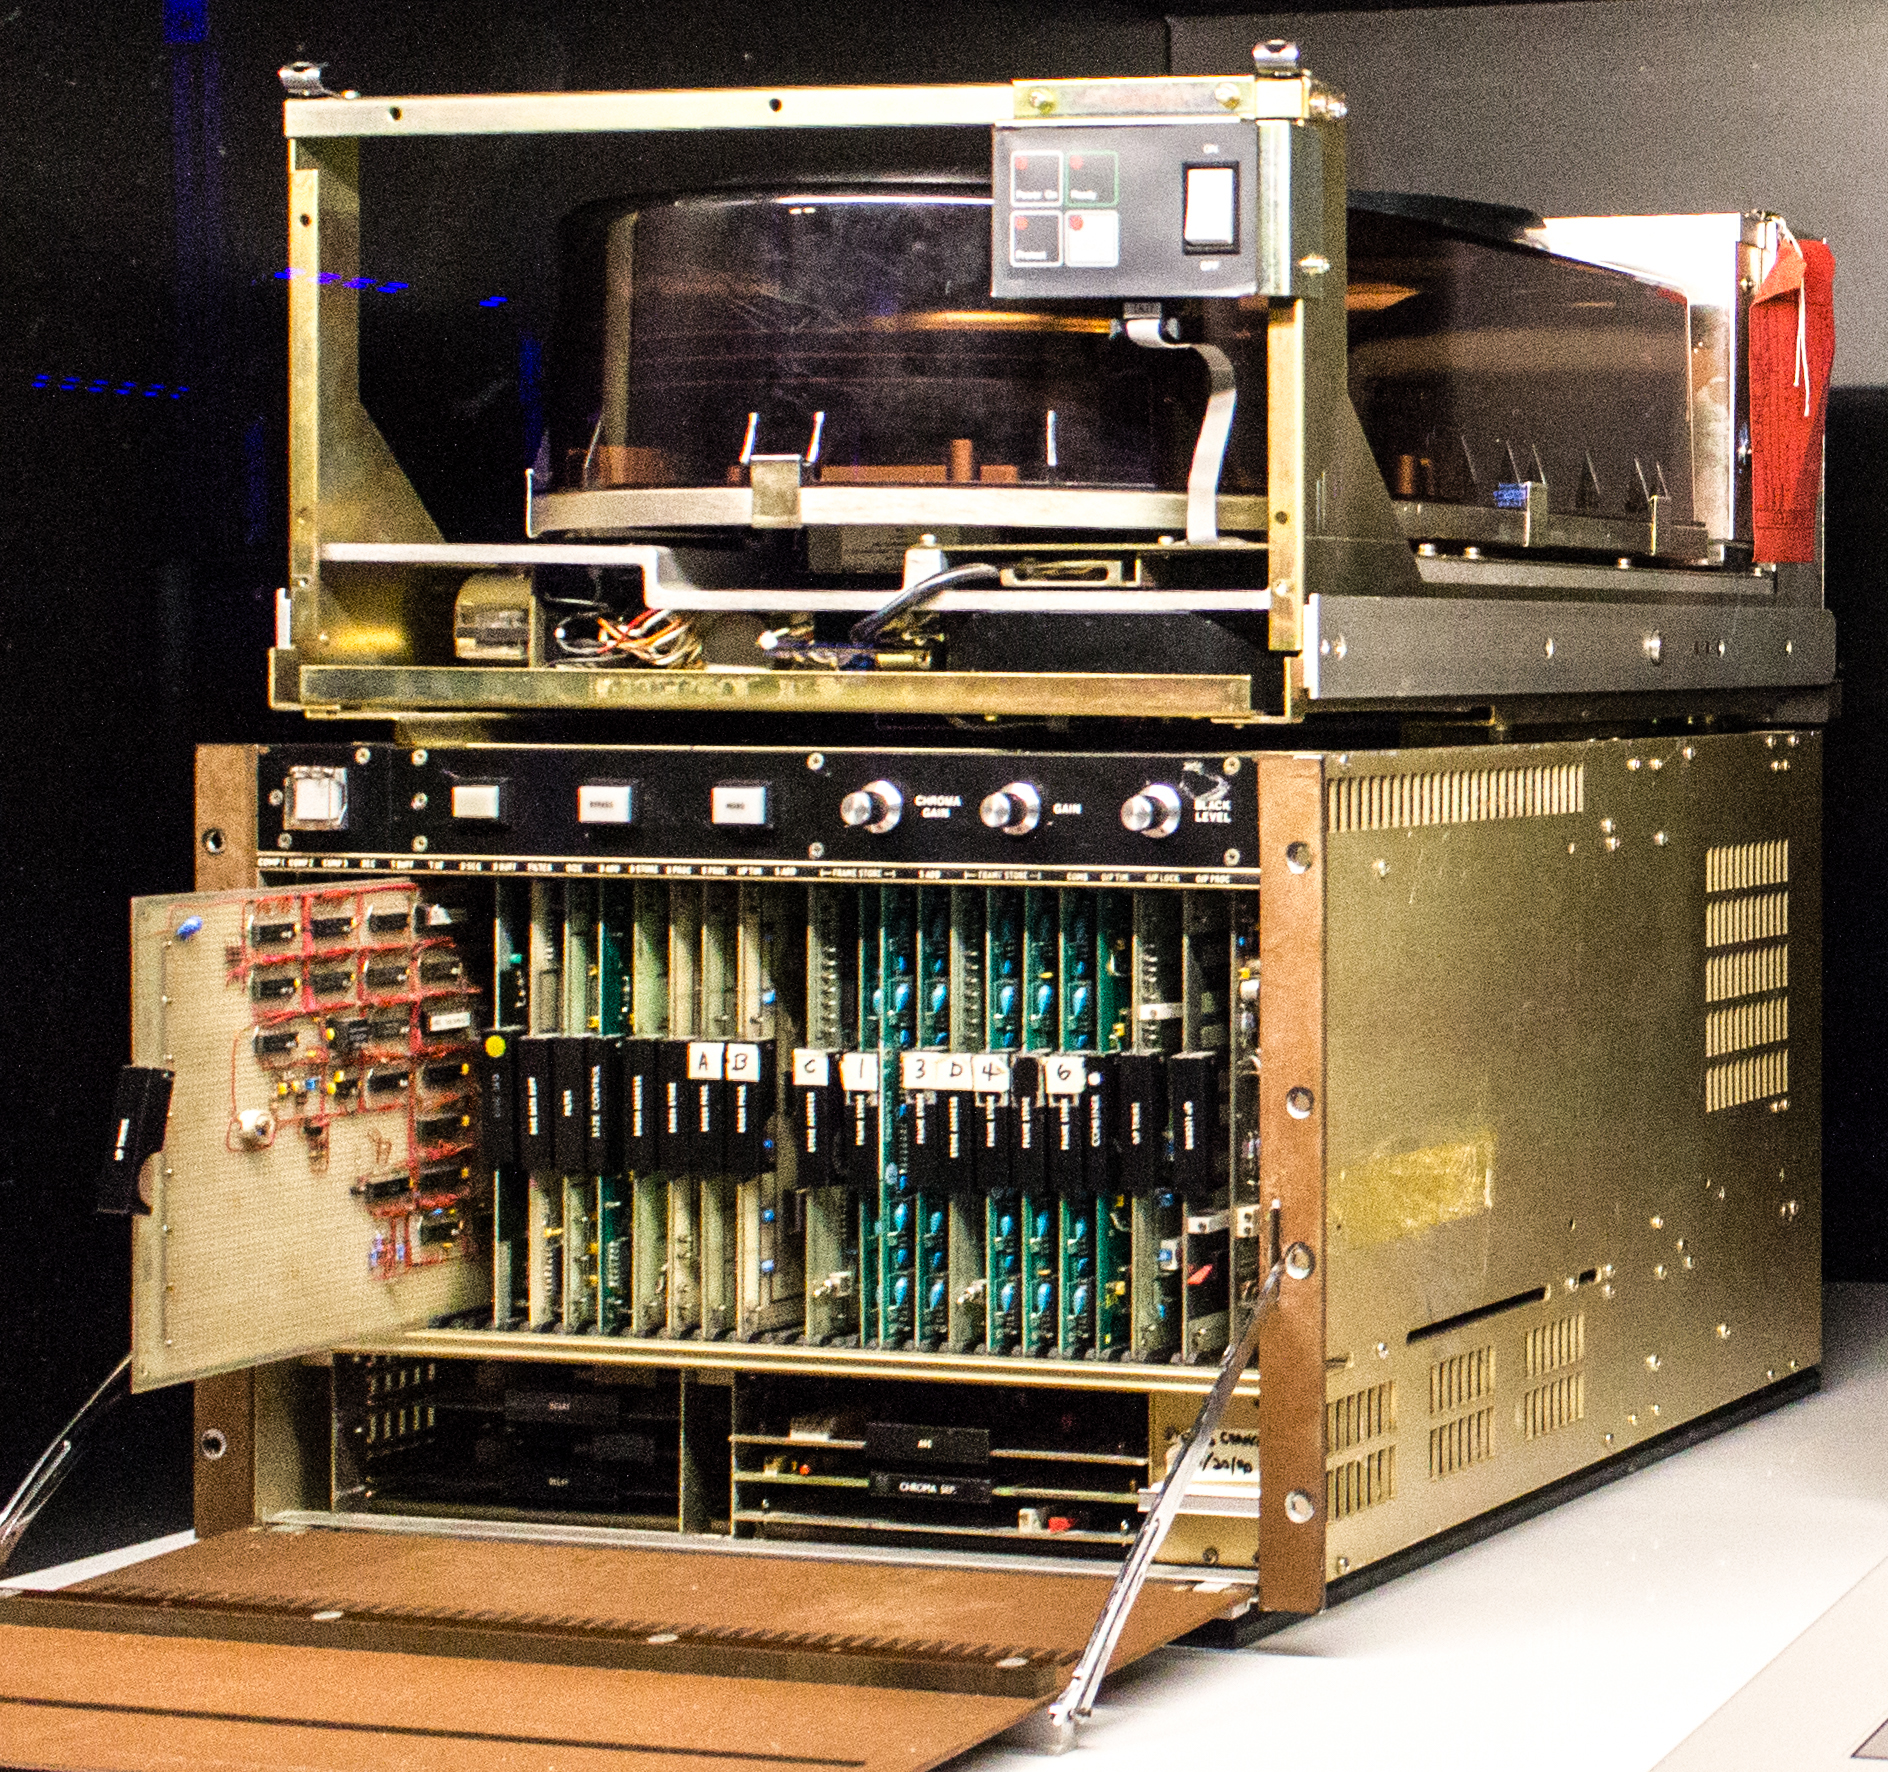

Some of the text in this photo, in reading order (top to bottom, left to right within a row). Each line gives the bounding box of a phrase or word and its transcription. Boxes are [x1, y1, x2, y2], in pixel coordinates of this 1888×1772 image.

[914, 795, 962, 807] CHROMA
[1194, 800, 1231, 811] BLACK
[921, 807, 951, 819] GAIN
[1053, 803, 1083, 815] GAIN
[1194, 812, 1232, 823] LEVEL
[698, 1052, 709, 1071] A
[731, 1052, 748, 1071] B
[804, 1059, 816, 1074] C
[915, 1059, 926, 1079] 3
[950, 1062, 963, 1077] D
[982, 1062, 998, 1081] 4
[1056, 1064, 1072, 1081] 6
[591, 1065, 601, 1111] CONTROL
[1091, 1095, 1101, 1148] COMBINER
[899, 1482, 937, 1494] CHROMA
